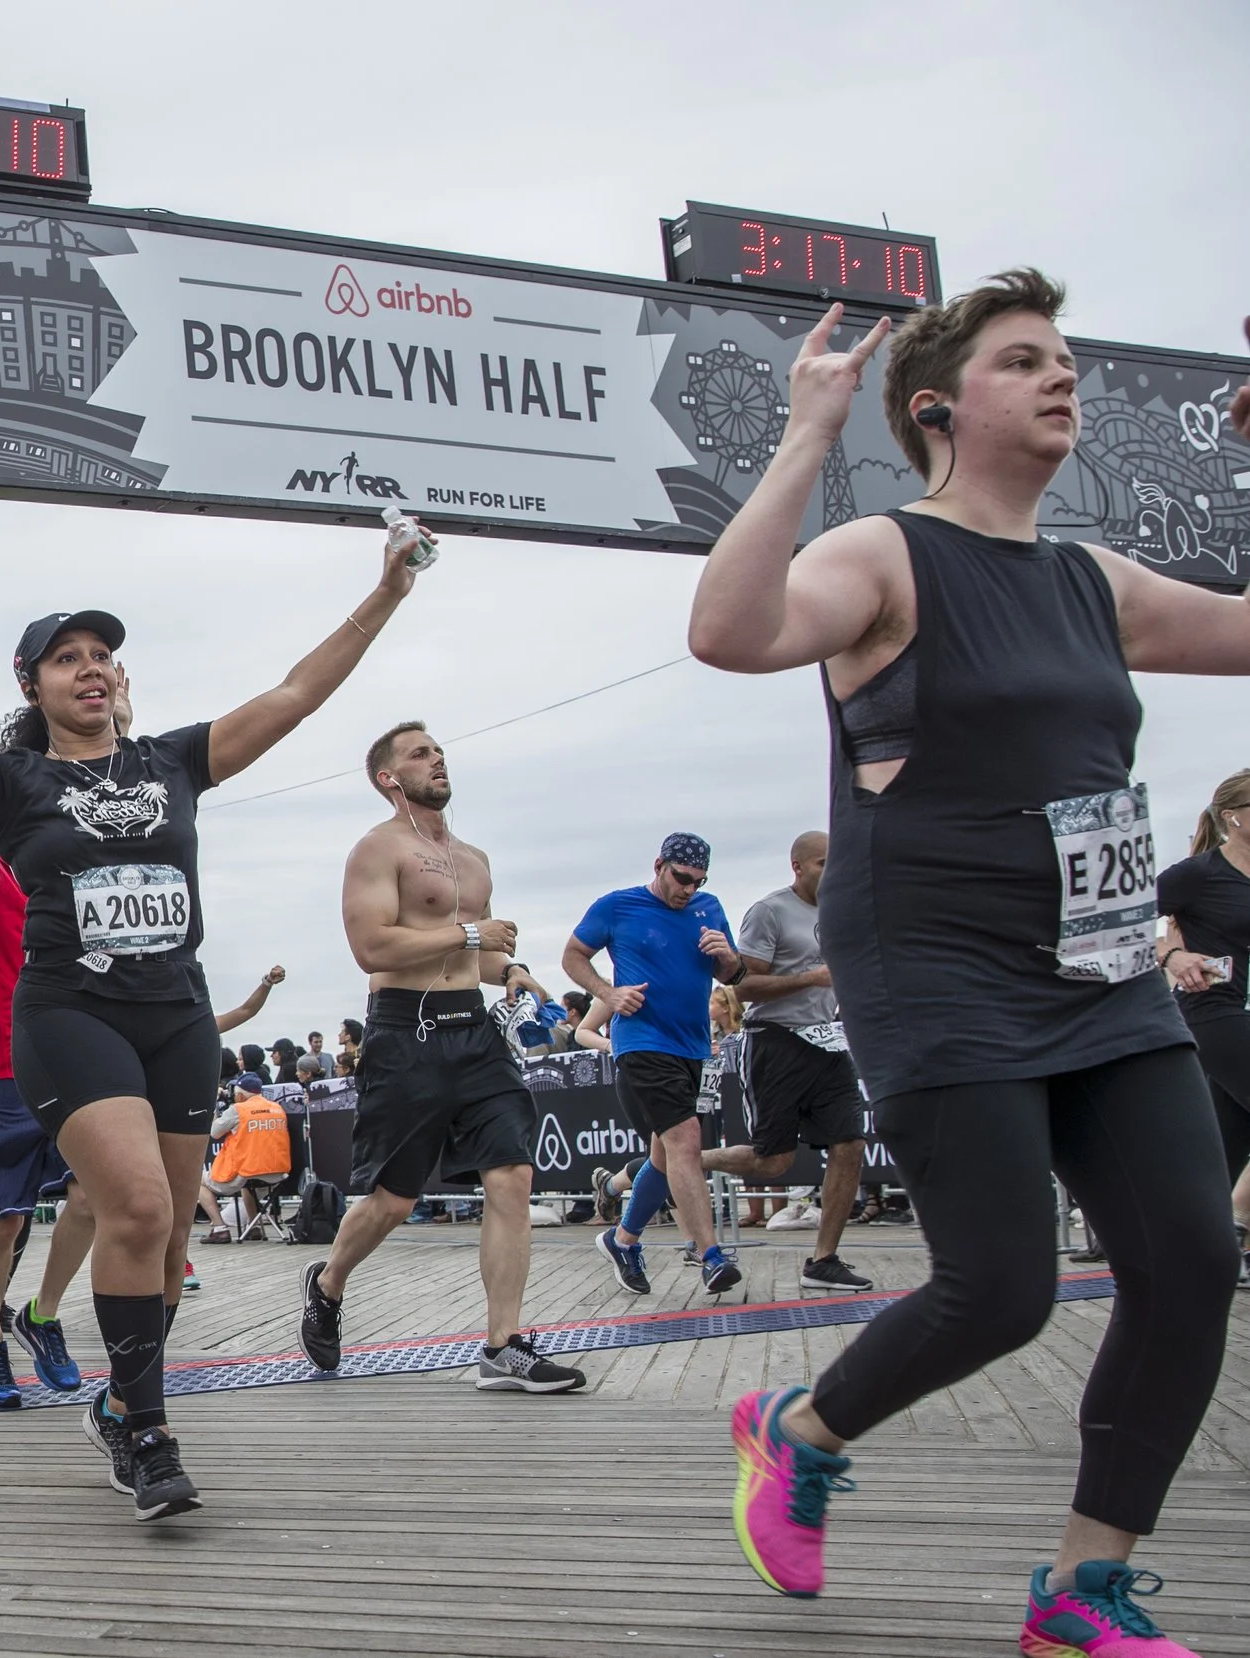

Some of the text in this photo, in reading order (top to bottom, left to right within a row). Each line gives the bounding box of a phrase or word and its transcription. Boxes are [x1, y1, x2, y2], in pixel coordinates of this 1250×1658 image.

[376, 280, 473, 319] airbnb
[182, 318, 607, 423] BROOKLYN HALF
[426, 487, 547, 513] RUN FOR LIFE
[1067, 832, 1155, 901] E 2855
[82, 891, 187, 931] A 20618
[83, 952, 108, 971] 0618
[576, 1118, 646, 1156] airbn
